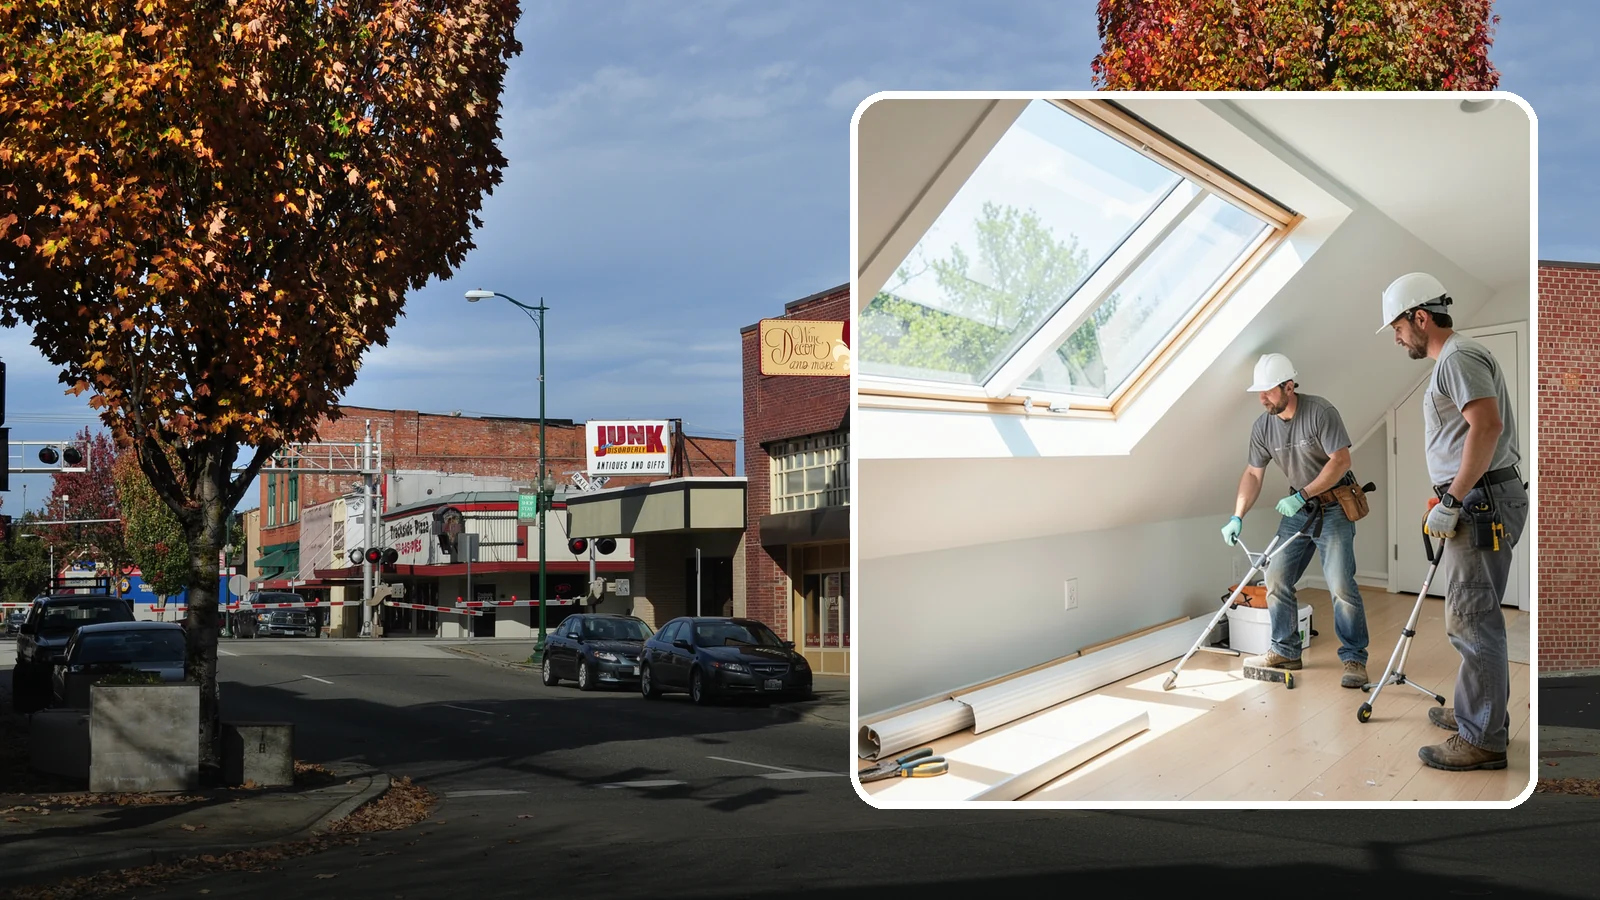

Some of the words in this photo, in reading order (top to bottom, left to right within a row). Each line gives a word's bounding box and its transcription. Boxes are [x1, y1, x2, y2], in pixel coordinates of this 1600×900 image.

[596, 425, 665, 457] JUNK
[607, 446, 645, 454] DISORDERLY
[597, 461, 628, 470] ANTIQUES
[631, 461, 644, 469] AND
[647, 460, 665, 469] GIFTS
[352, 498, 365, 511] CRO
[390, 521, 413, 539] Trackside
[415, 519, 429, 534] Pizza
